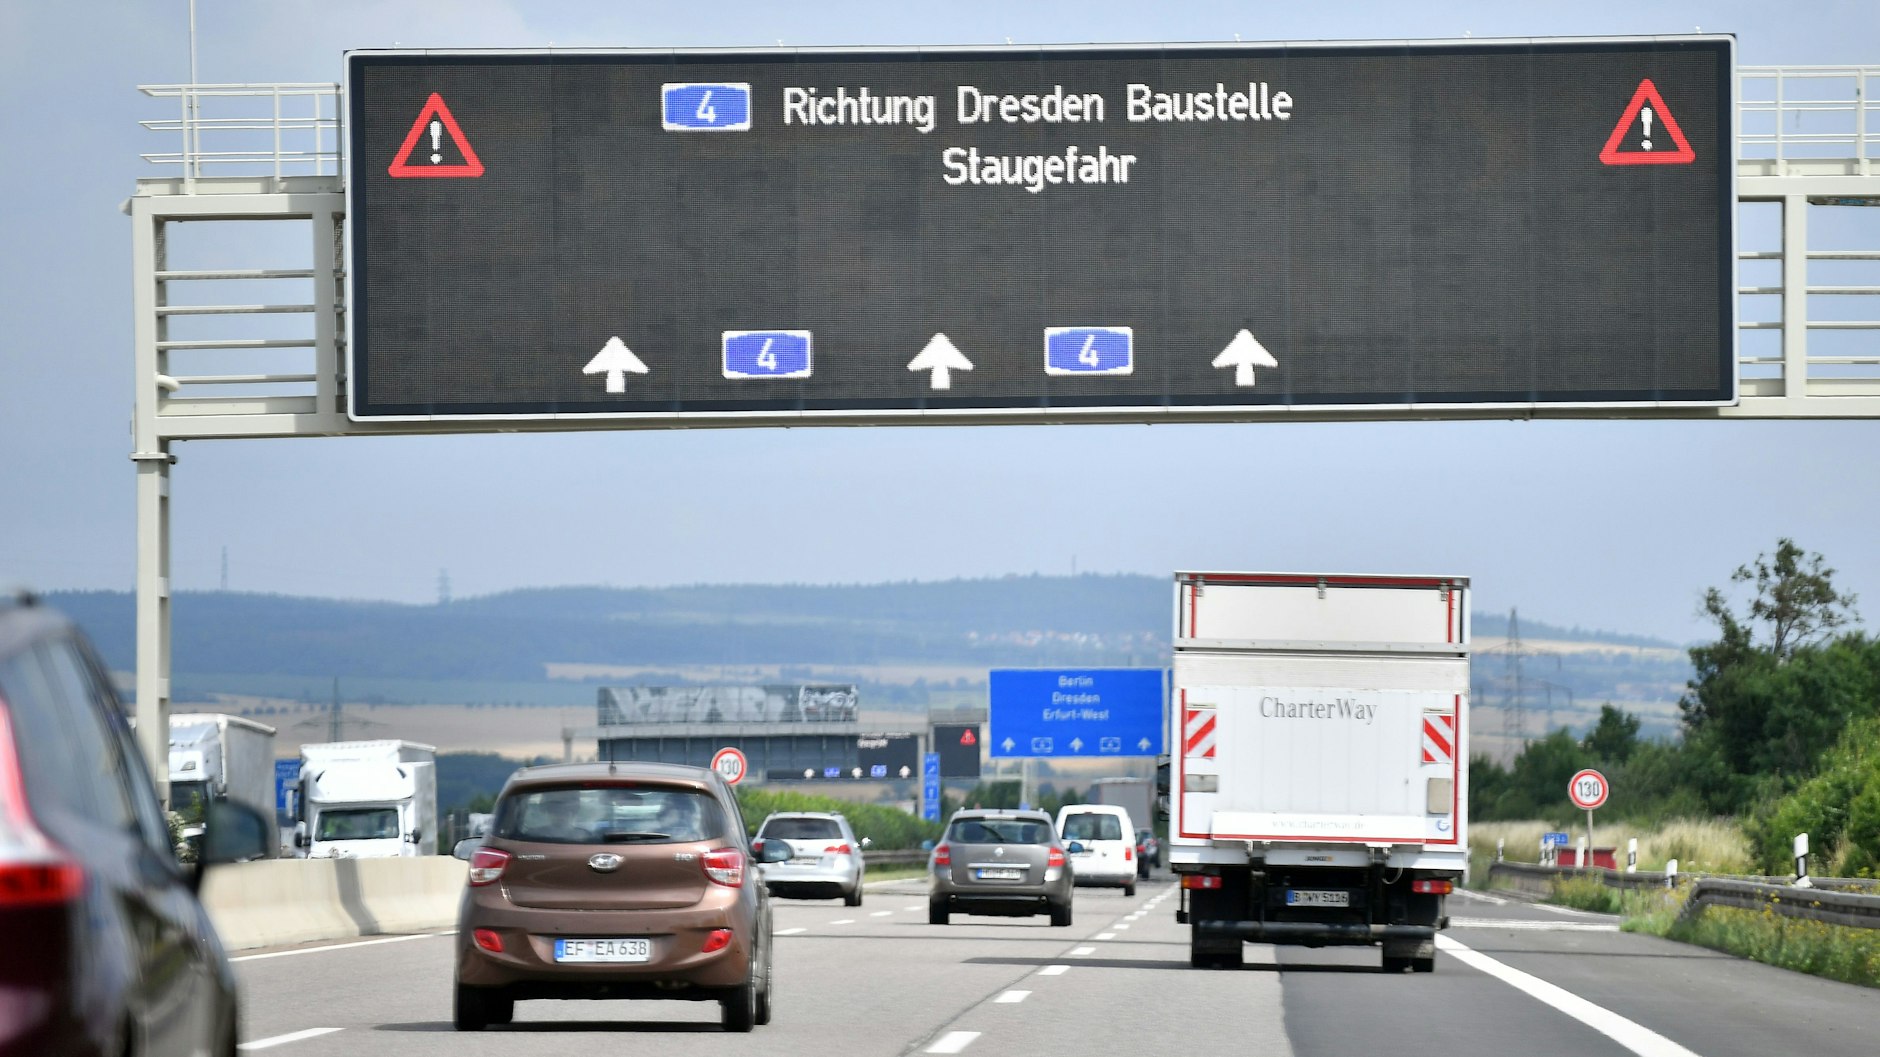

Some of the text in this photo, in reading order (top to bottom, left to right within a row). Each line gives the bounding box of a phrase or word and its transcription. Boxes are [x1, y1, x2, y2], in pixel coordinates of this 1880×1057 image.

[696, 82, 1293, 133] 4 Richtung Dresden Baustelle
[942, 146, 1137, 193] Staugefahr
[757, 334, 1099, 371] 4 4
[1058, 675, 1093, 687] Berlin
[1052, 691, 1100, 704] Dresden
[1042, 708, 1109, 721] Erfurt-West
[1260, 696, 1377, 725] CharterWay
[720, 759, 740, 775] 130
[1578, 781, 1600, 797] 130
[565, 941, 647, 955] EF EA 638
